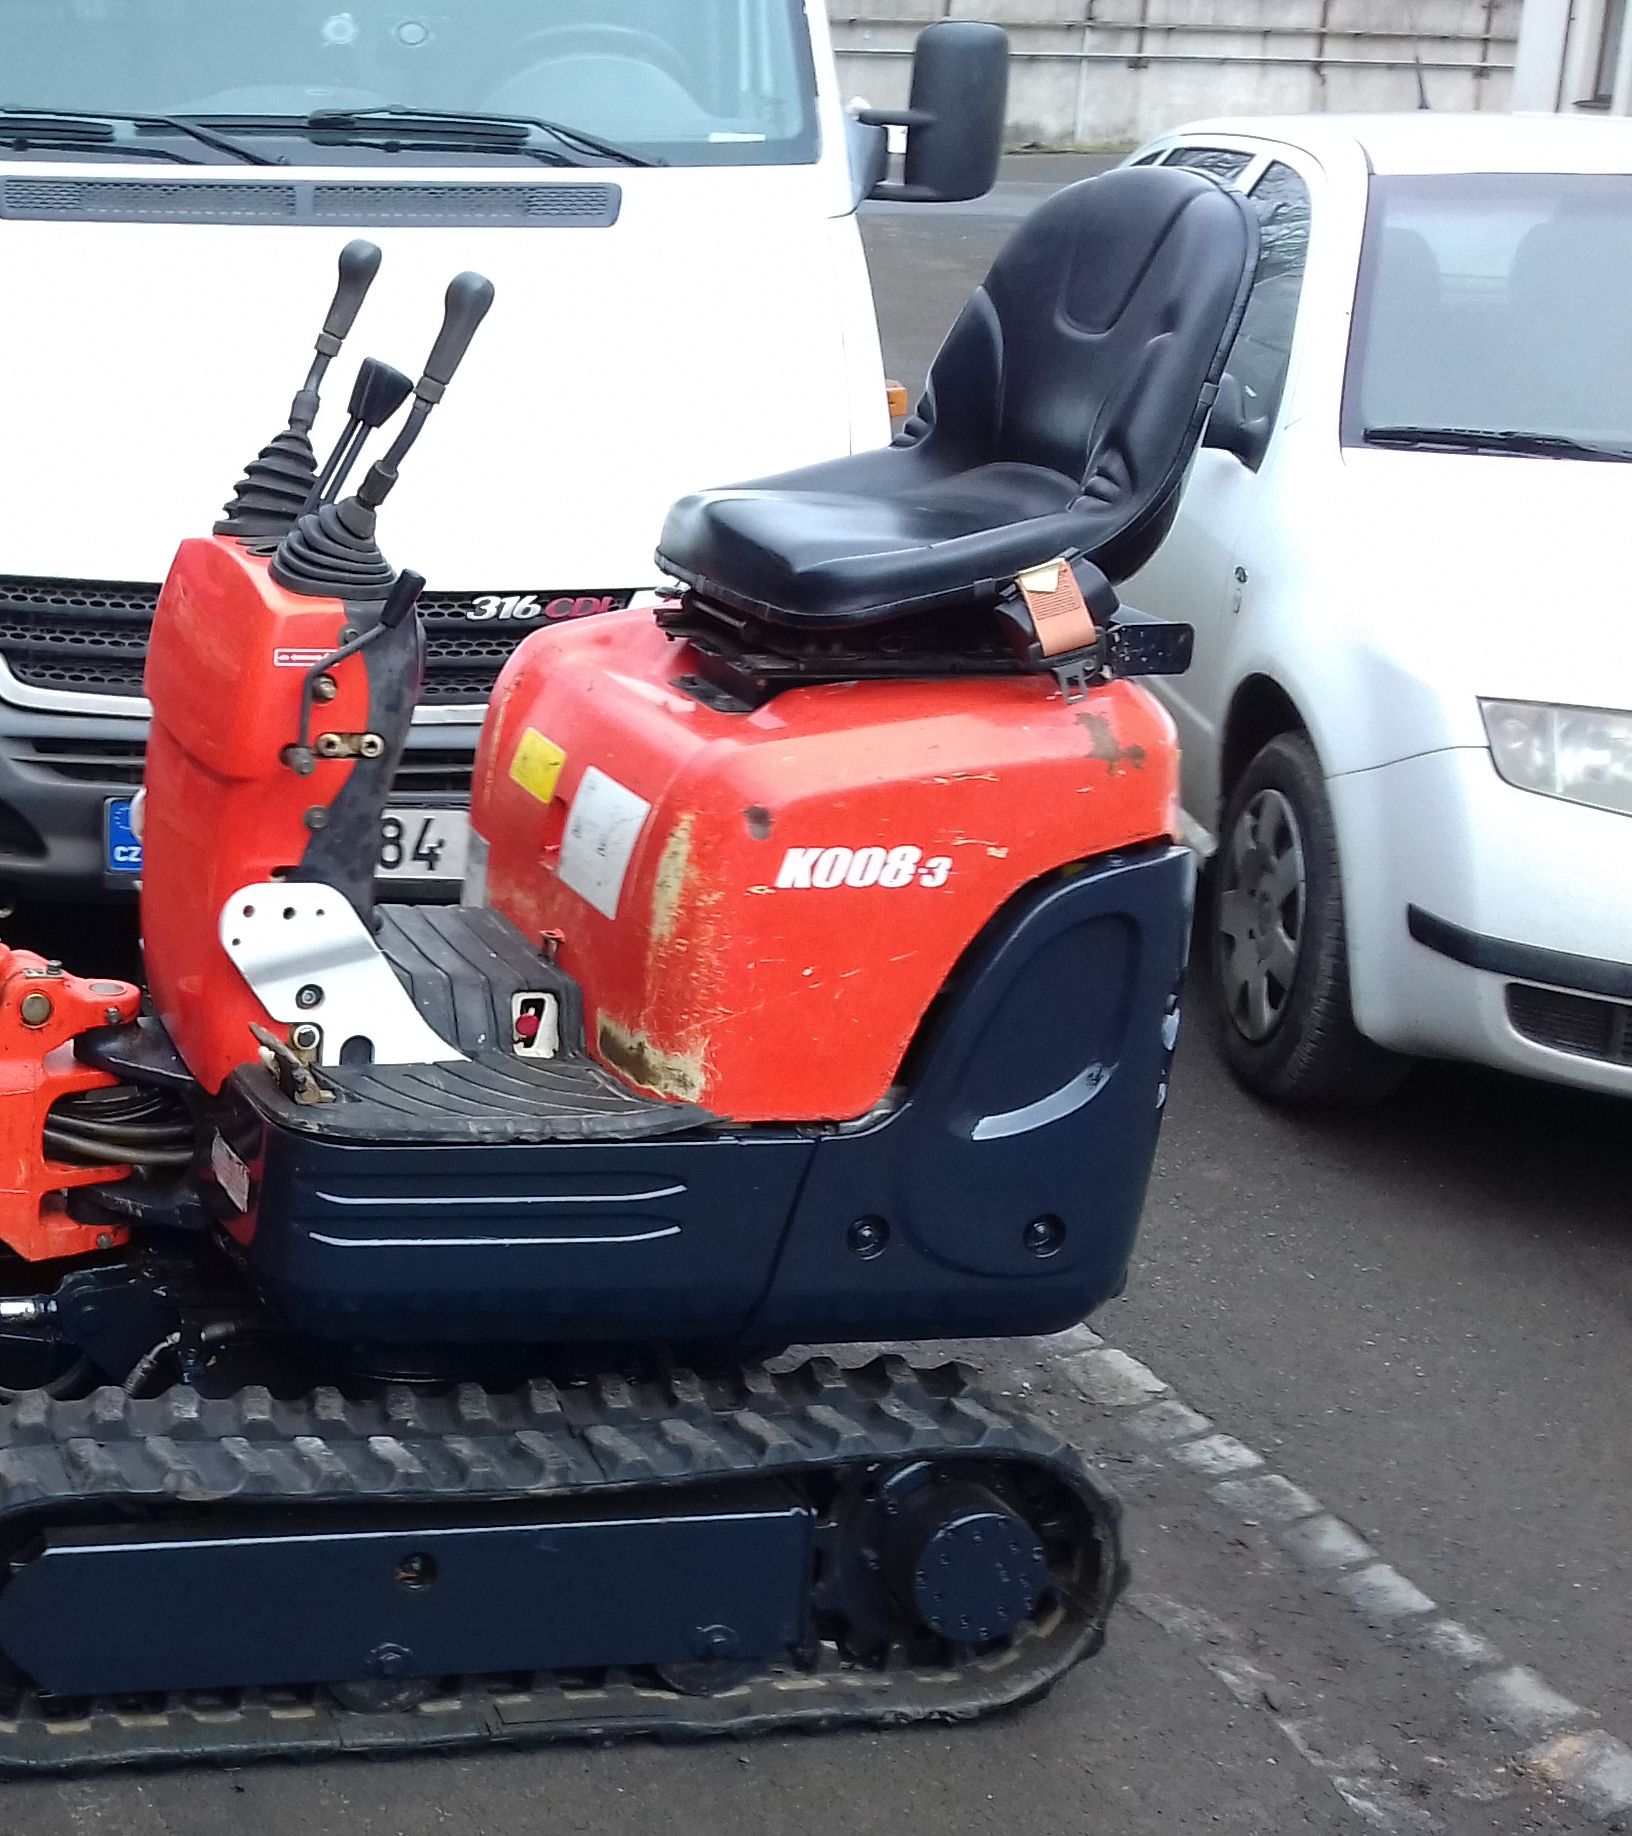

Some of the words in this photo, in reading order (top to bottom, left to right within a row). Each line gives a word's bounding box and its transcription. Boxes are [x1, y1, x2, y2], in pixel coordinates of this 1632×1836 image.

[466, 595, 542, 620] 316
[545, 596, 614, 618] CDI
[113, 845, 143, 862] CZ
[775, 845, 953, 888] K008-3
